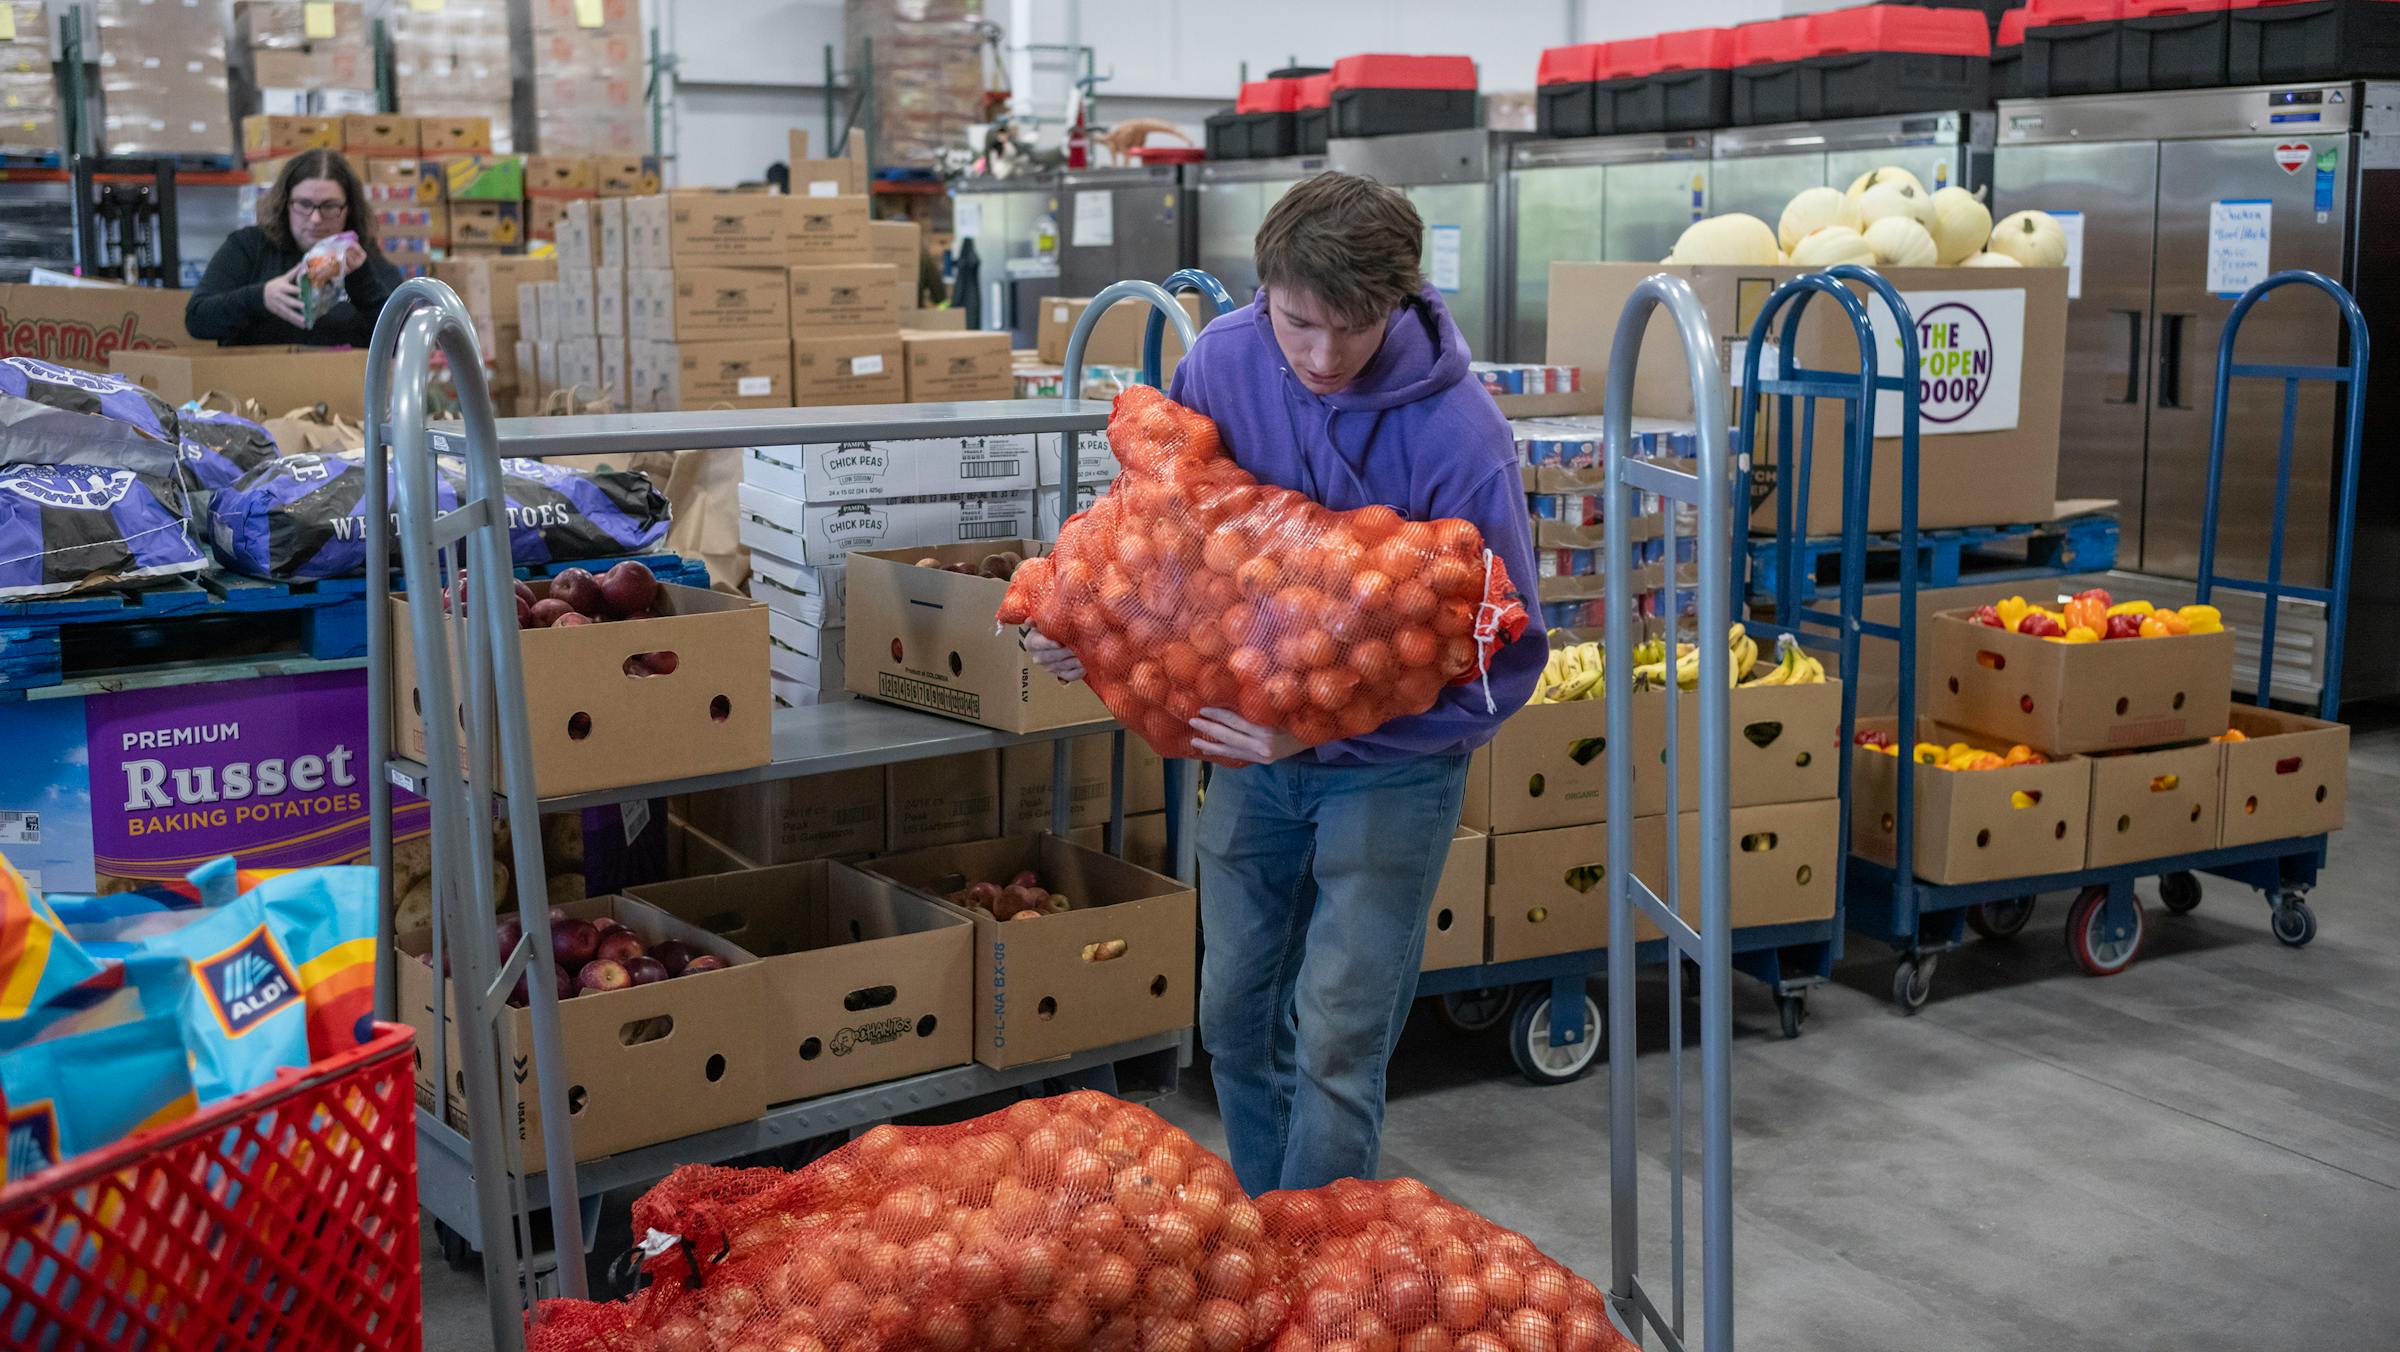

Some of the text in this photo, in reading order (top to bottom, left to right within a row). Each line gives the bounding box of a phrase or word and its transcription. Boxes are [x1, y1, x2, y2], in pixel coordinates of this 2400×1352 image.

[1921, 323, 1959, 349] THE
[1929, 350, 1986, 377] OPEN
[1088, 441, 1109, 450] PEAS
[829, 456, 883, 470] CHICK PEAS
[15, 481, 84, 505] FARMS
[829, 519, 882, 534] CHICK PEAS
[1021, 690, 1029, 703] LV
[122, 722, 240, 751] PREMIUM
[122, 744, 357, 812] Russet
[1565, 790, 1600, 801] ORGANIC
[128, 793, 362, 837] BAKING POTATOES
[230, 976, 289, 1022] ALDI
